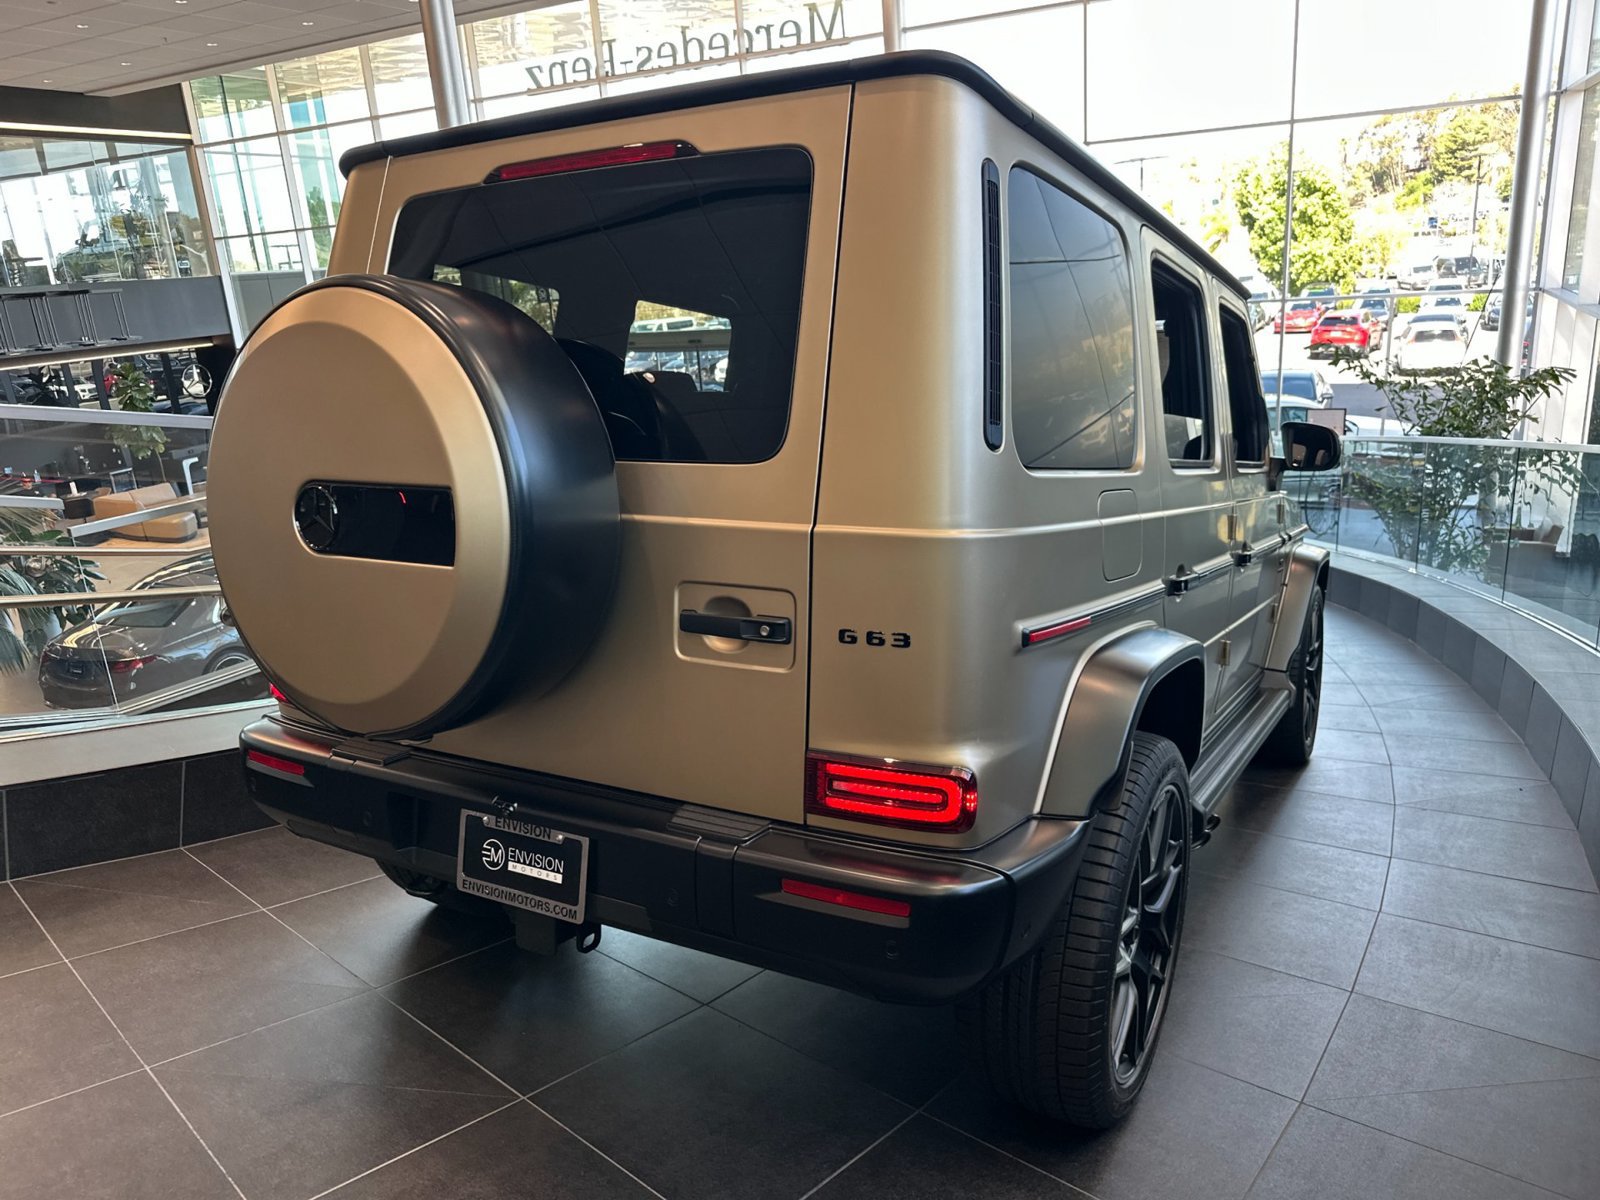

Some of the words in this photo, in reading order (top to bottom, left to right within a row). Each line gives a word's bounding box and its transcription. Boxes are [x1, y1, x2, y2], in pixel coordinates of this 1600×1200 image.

[838, 628, 858, 645] G
[866, 630, 911, 649] 63
[495, 816, 551, 840] ENVISION
[508, 847, 564, 873] ENVISION
[511, 863, 558, 881] MOTORS
[462, 878, 578, 921] ENVISIONMOTORS.COM
